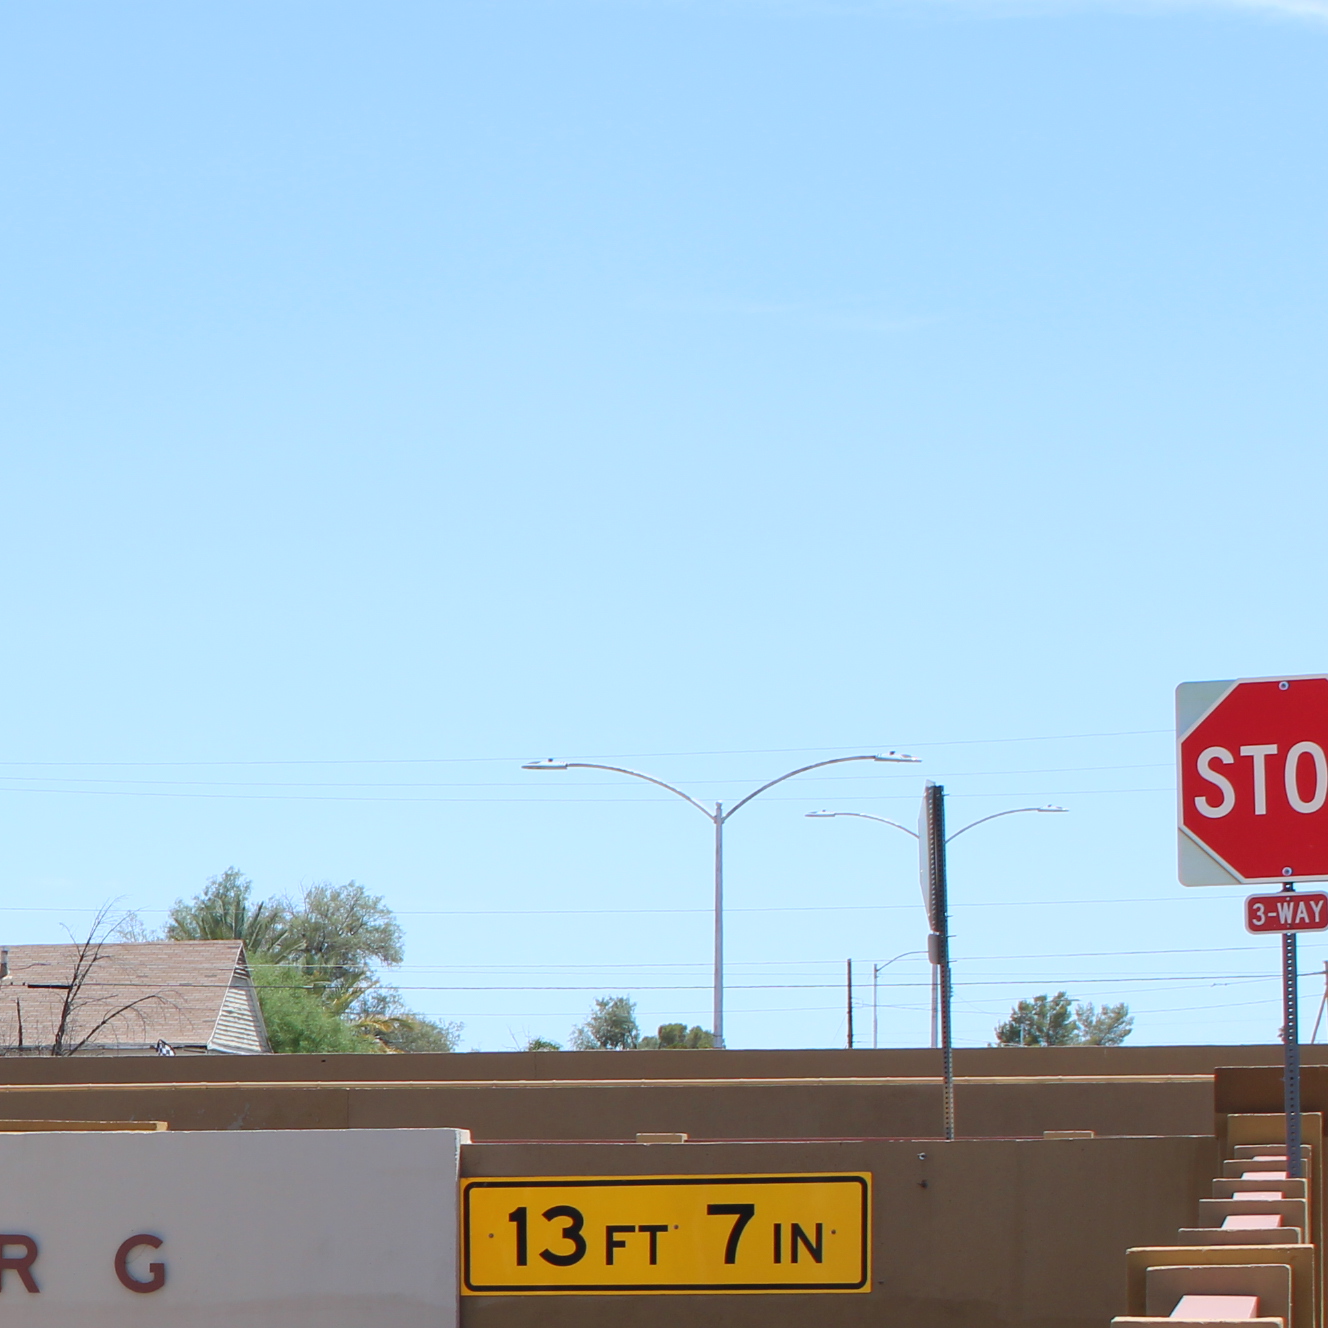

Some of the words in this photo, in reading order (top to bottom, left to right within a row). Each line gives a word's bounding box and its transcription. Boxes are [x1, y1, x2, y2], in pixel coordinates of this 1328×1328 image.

[1194, 741, 1328, 818] STO
[1252, 900, 1324, 926] 3-WAY
[508, 1205, 587, 1267] 13
[605, 1224, 669, 1265] FT
[706, 1203, 755, 1265] 7
[773, 1222, 823, 1264] IN
